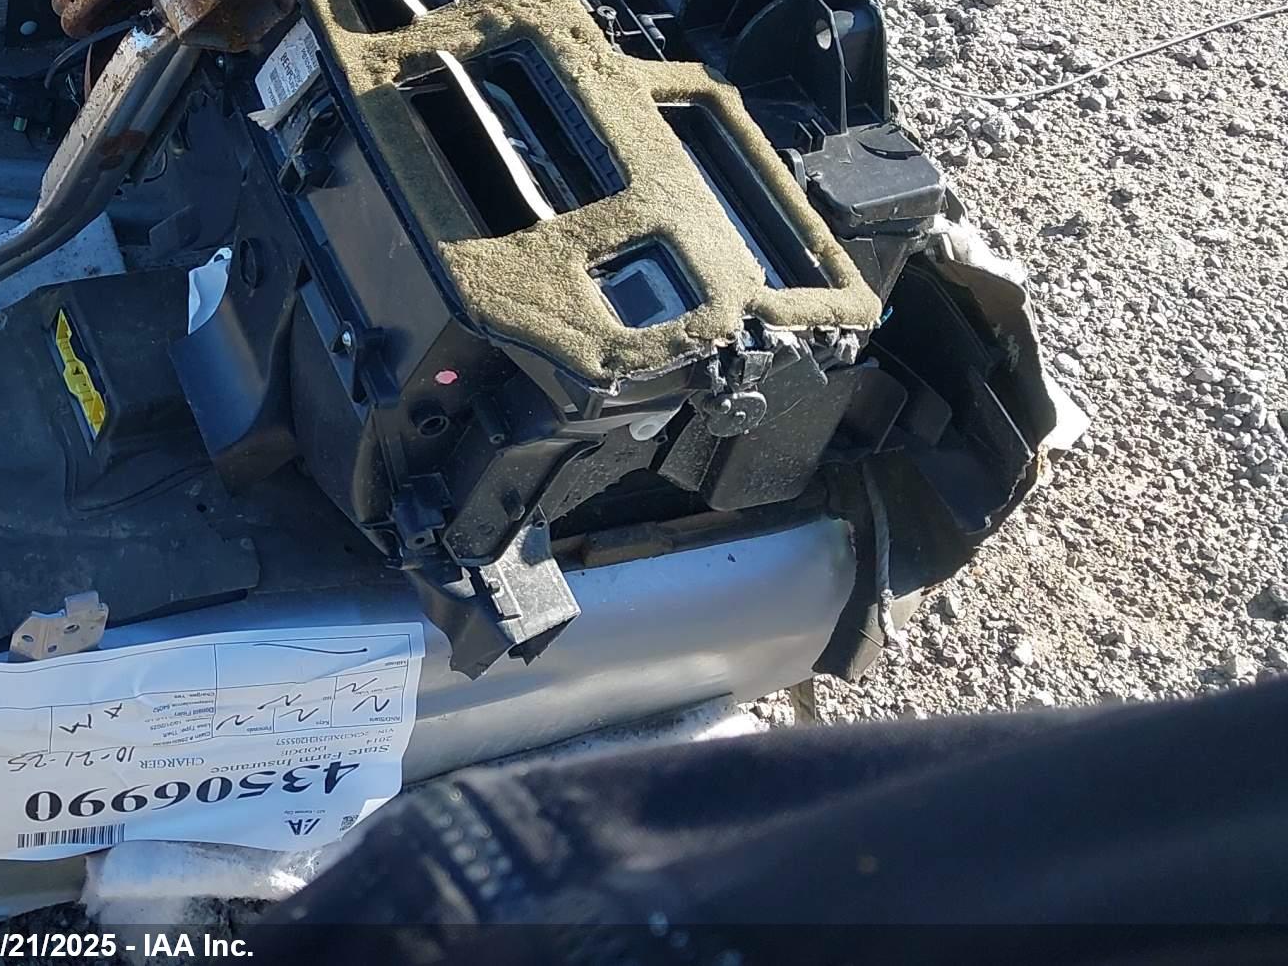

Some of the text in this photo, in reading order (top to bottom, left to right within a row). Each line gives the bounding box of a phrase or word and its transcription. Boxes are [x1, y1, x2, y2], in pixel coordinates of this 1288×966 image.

[366, 736, 393, 744] 2014
[7, 746, 135, 771] 10-21-25
[210, 744, 390, 774] State Farm Insurance
[280, 746, 327, 756] DODGE
[138, 757, 204, 769] CHARGER
[25, 761, 360, 822] 43506990
